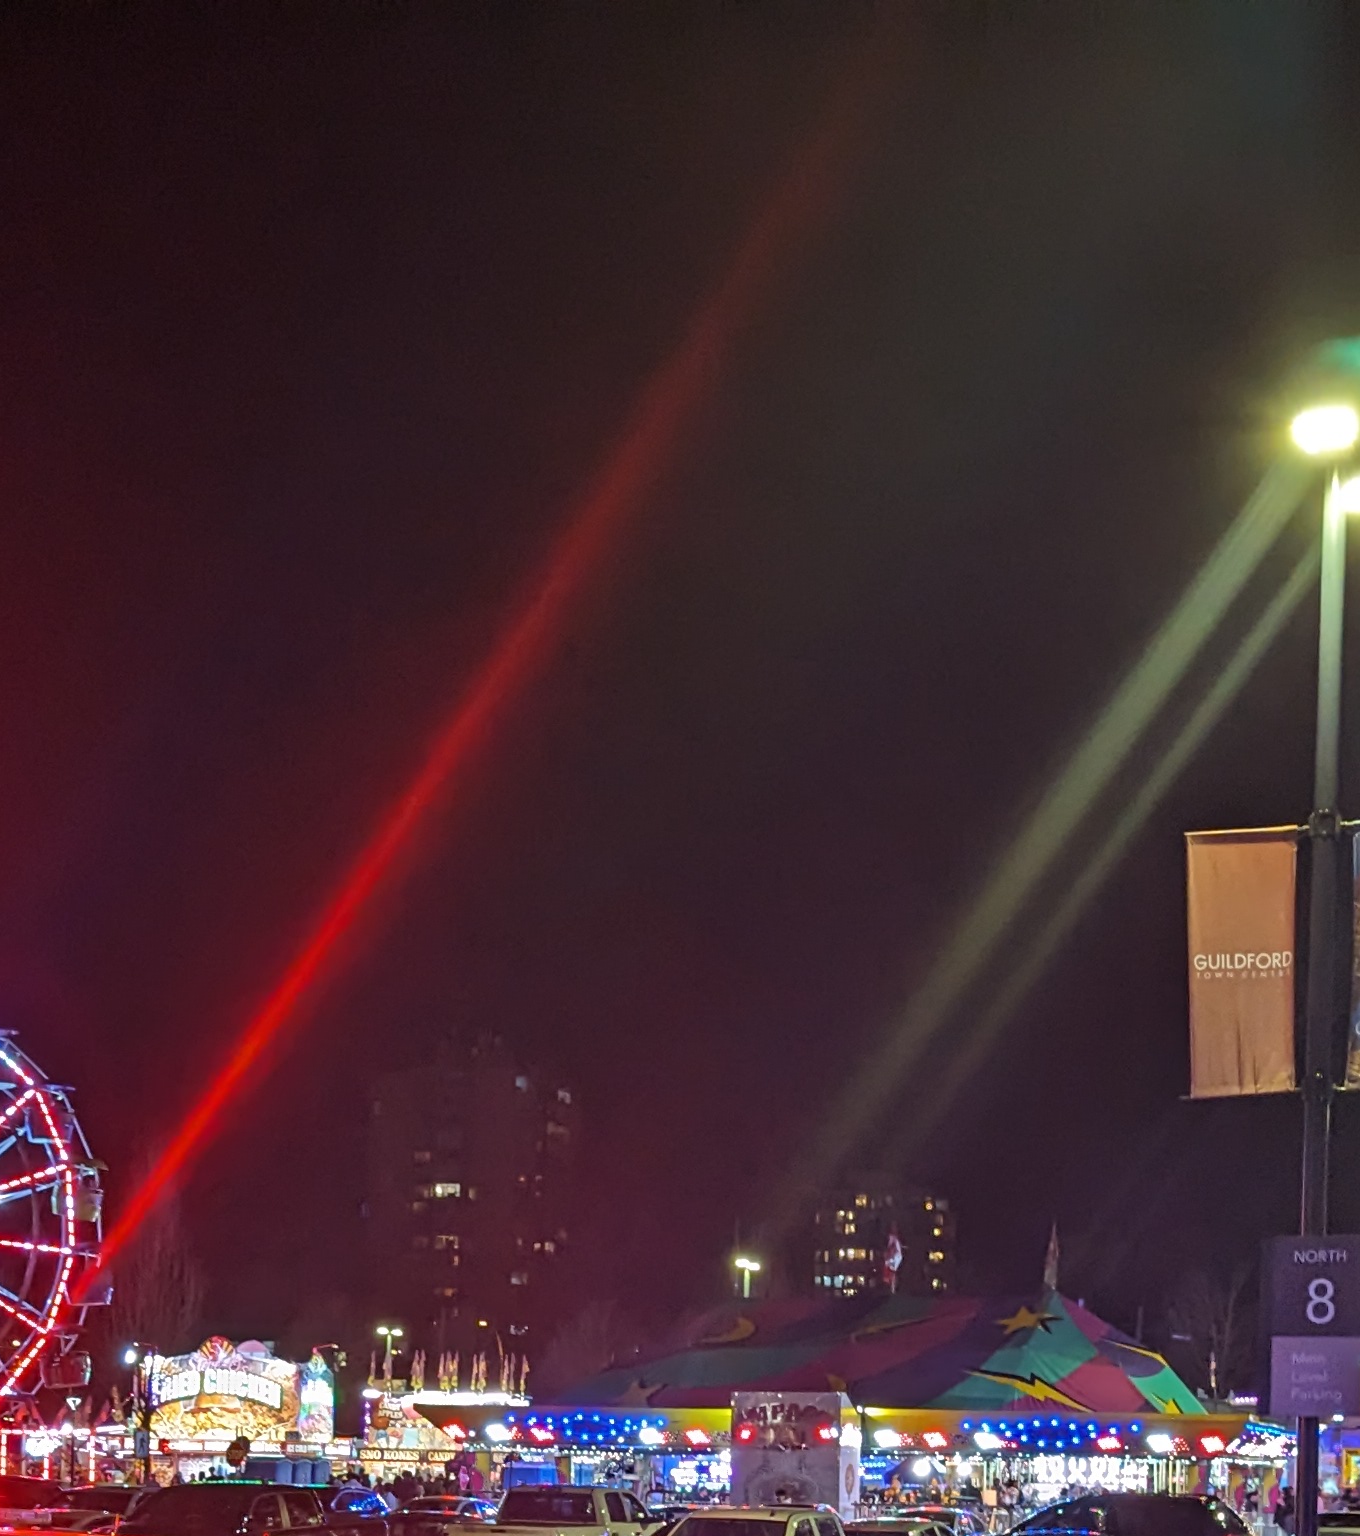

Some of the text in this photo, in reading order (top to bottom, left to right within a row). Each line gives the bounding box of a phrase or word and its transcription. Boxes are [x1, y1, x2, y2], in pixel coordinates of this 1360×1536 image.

[1193, 951, 1292, 970] GUILDFORD
[1196, 970, 1234, 979] TOWN
[1294, 1250, 1347, 1264] NORTH
[1306, 1277, 1335, 1325] 8
[203, 1368, 282, 1409] CHICKEN
[360, 1450, 382, 1461] SNO
[383, 1450, 419, 1461] KONES
[428, 1451, 456, 1462] CANDY
